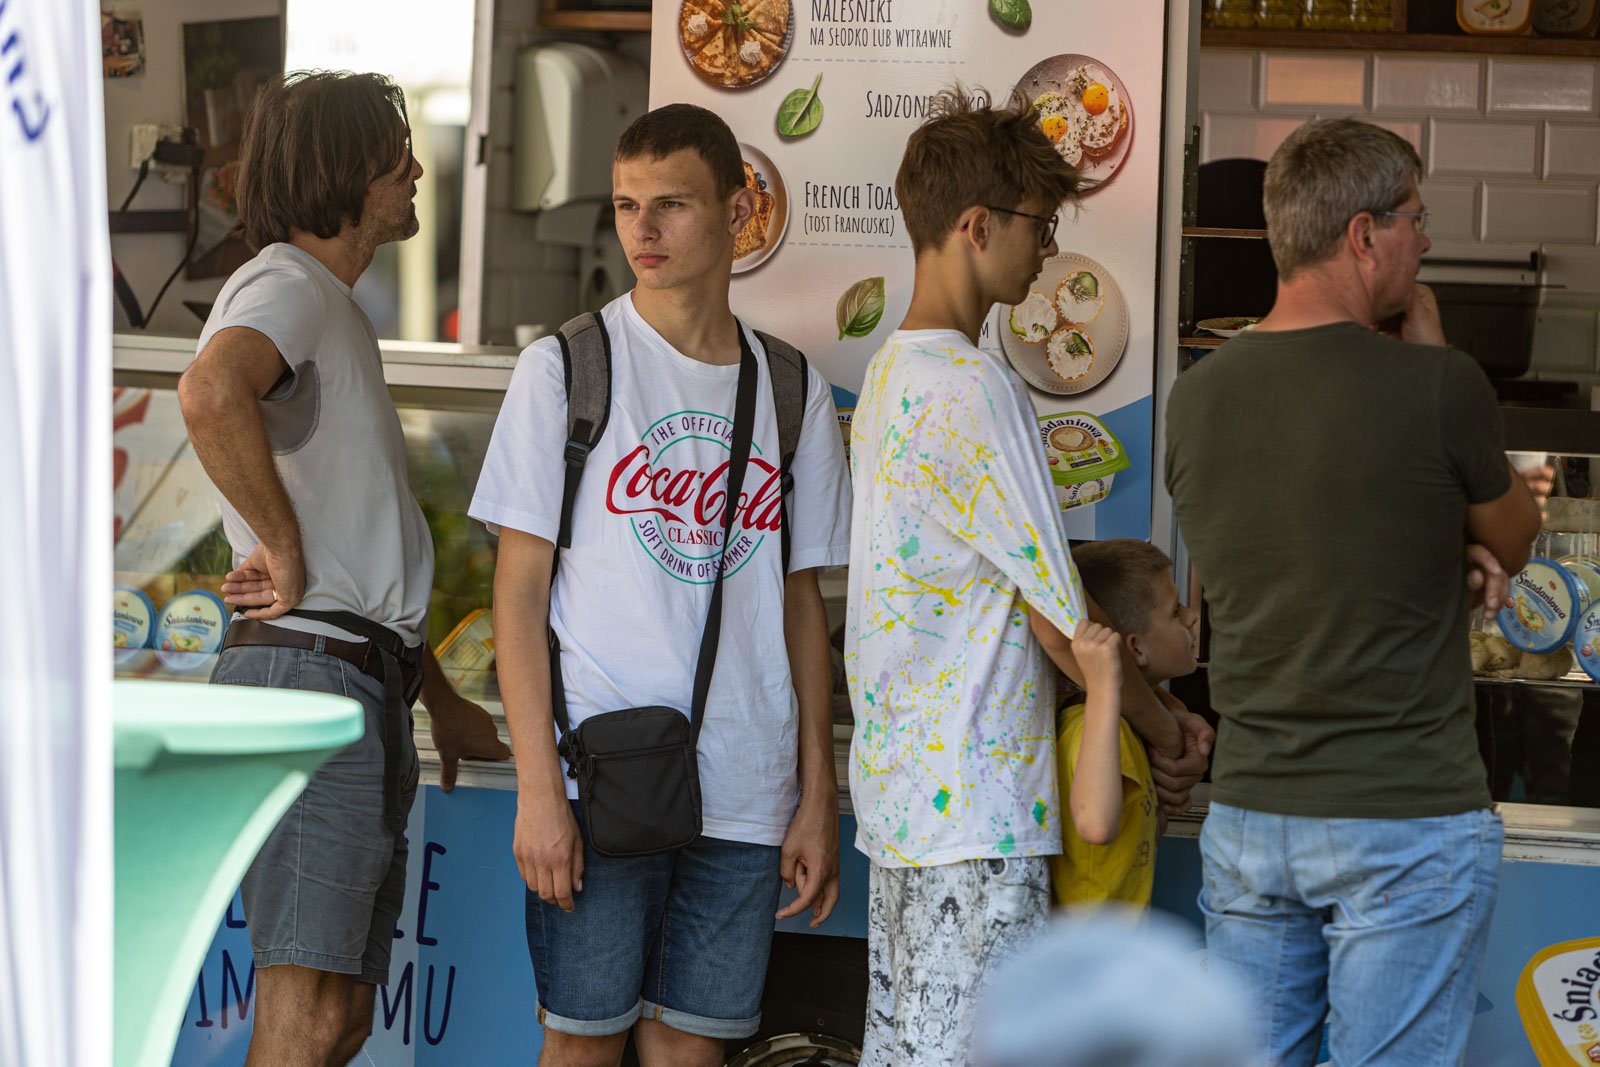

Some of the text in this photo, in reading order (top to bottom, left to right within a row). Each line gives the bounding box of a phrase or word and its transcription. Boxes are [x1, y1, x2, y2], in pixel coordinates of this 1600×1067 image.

[810, 27, 952, 48] NA SŁODKO LUB WYTRAWNE
[805, 181, 860, 209] FRENCH
[804, 213, 895, 237] (TOST FRANCUSKI)
[651, 416, 734, 446] THE OFFICIA
[639, 520, 663, 550] SOFT
[660, 548, 693, 577] DRINK
[697, 562, 711, 578] OF
[668, 527, 723, 547] CLASSIC
